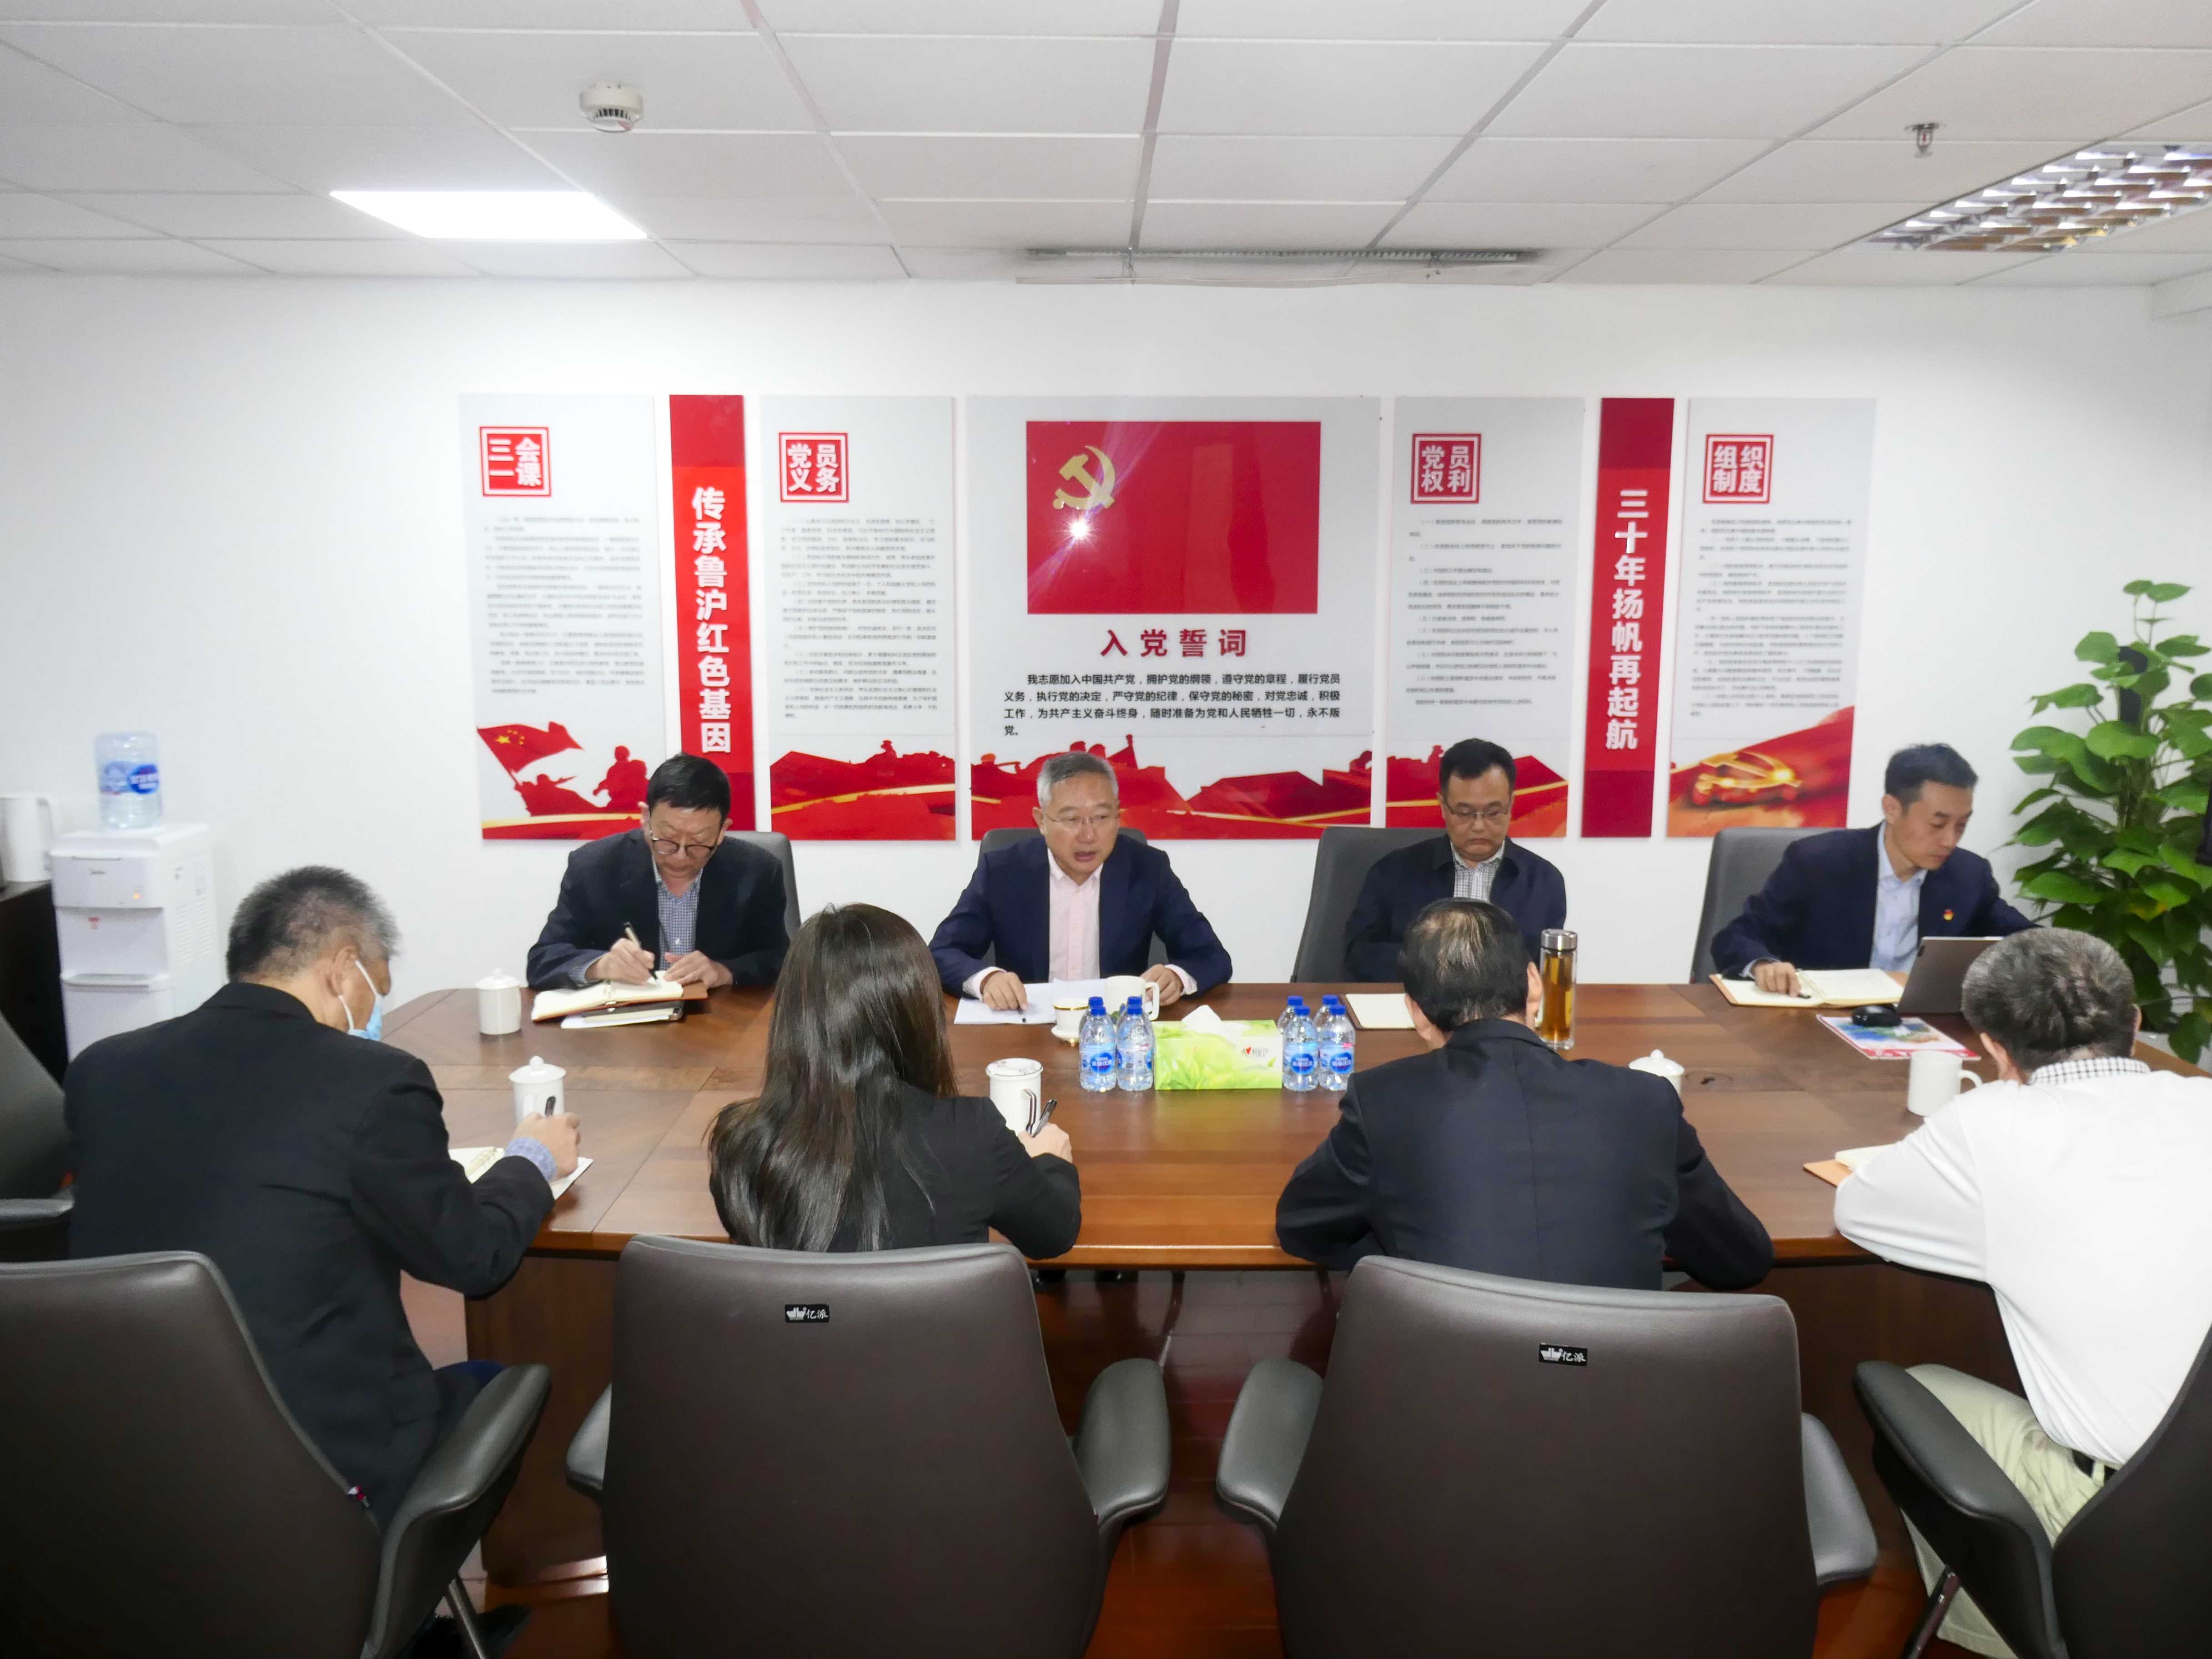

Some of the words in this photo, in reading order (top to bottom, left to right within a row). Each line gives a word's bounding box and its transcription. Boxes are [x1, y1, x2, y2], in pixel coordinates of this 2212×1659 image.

[489, 437, 541, 463] 三会
[787, 443, 839, 468] 党员
[1421, 445, 1471, 470] 党员
[1713, 445, 1765, 469] 组织
[787, 467, 840, 493] 义务
[1420, 469, 1470, 493] 权利
[1712, 469, 1763, 493] 制度
[691, 486, 732, 754] 传承鲁沪红色基因
[1605, 489, 1649, 750] 三十年扬帆再起航
[1101, 628, 1247, 657] 入党誓词
[806, 1309, 829, 1319] 亿派
[1562, 1351, 1586, 1362] 亿派
